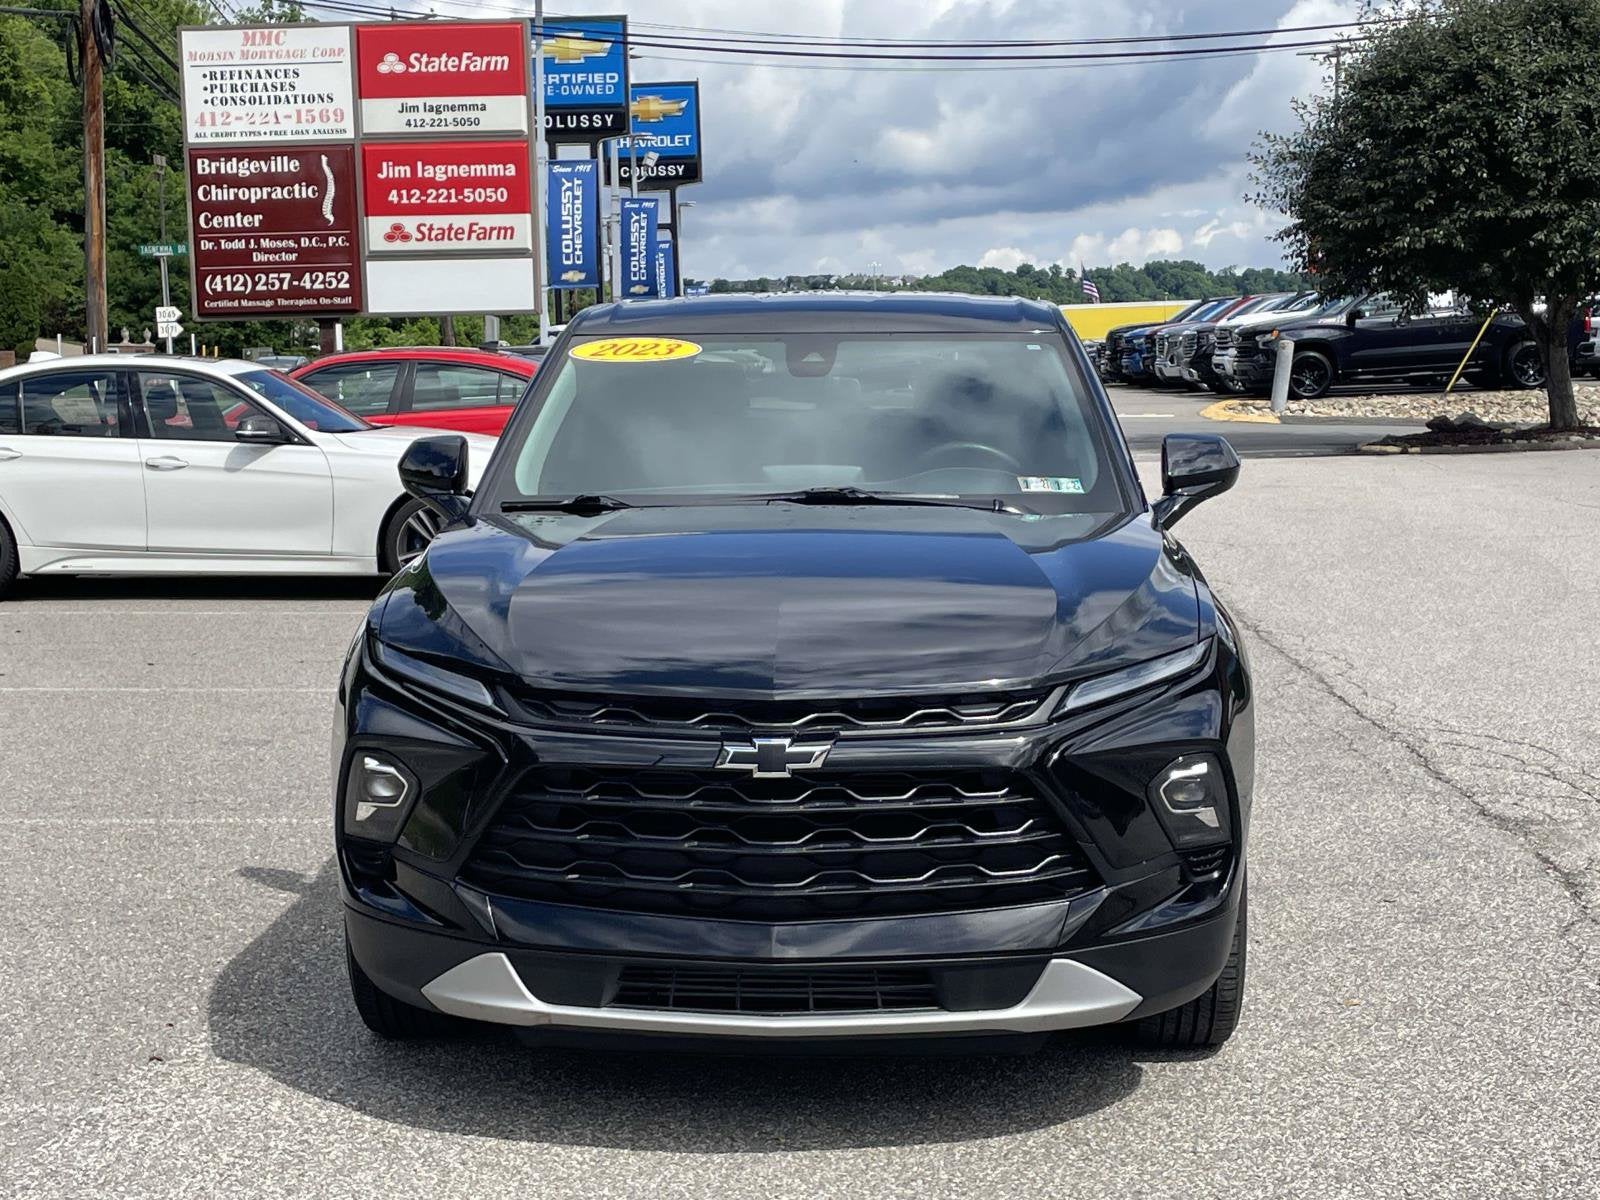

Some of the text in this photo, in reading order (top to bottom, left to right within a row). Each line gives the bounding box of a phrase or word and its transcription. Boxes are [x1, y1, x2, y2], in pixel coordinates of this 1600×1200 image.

[241, 30, 287, 47] MMC
[195, 107, 345, 127] 412-221-1569
[398, 102, 487, 115] Jim Iagnemma
[405, 117, 481, 128] 412-221-5050
[534, 114, 614, 128] OLUSSY
[196, 155, 300, 177] Bridgeville
[377, 161, 516, 181] Jim Iagnemma
[198, 182, 319, 203] Chiropractic
[388, 187, 508, 204] 412-221-5050
[199, 212, 263, 228] Center
[561, 178, 573, 265] COLUSSY
[574, 177, 583, 264] CHEVROLET
[200, 239, 217, 250] Dr.
[219, 239, 245, 250] Todd
[248, 239, 258, 249] J.
[260, 238, 298, 249] Moses,
[328, 236, 350, 247] P.C.
[630, 211, 640, 280] COLUSSY
[640, 212, 648, 280] CHEVROLET
[253, 252, 298, 262] Director
[204, 271, 350, 295] (412) 257-4252
[204, 296, 352, 308] Certified Massage Therapists On-Staff
[591, 342, 682, 357] 2023
